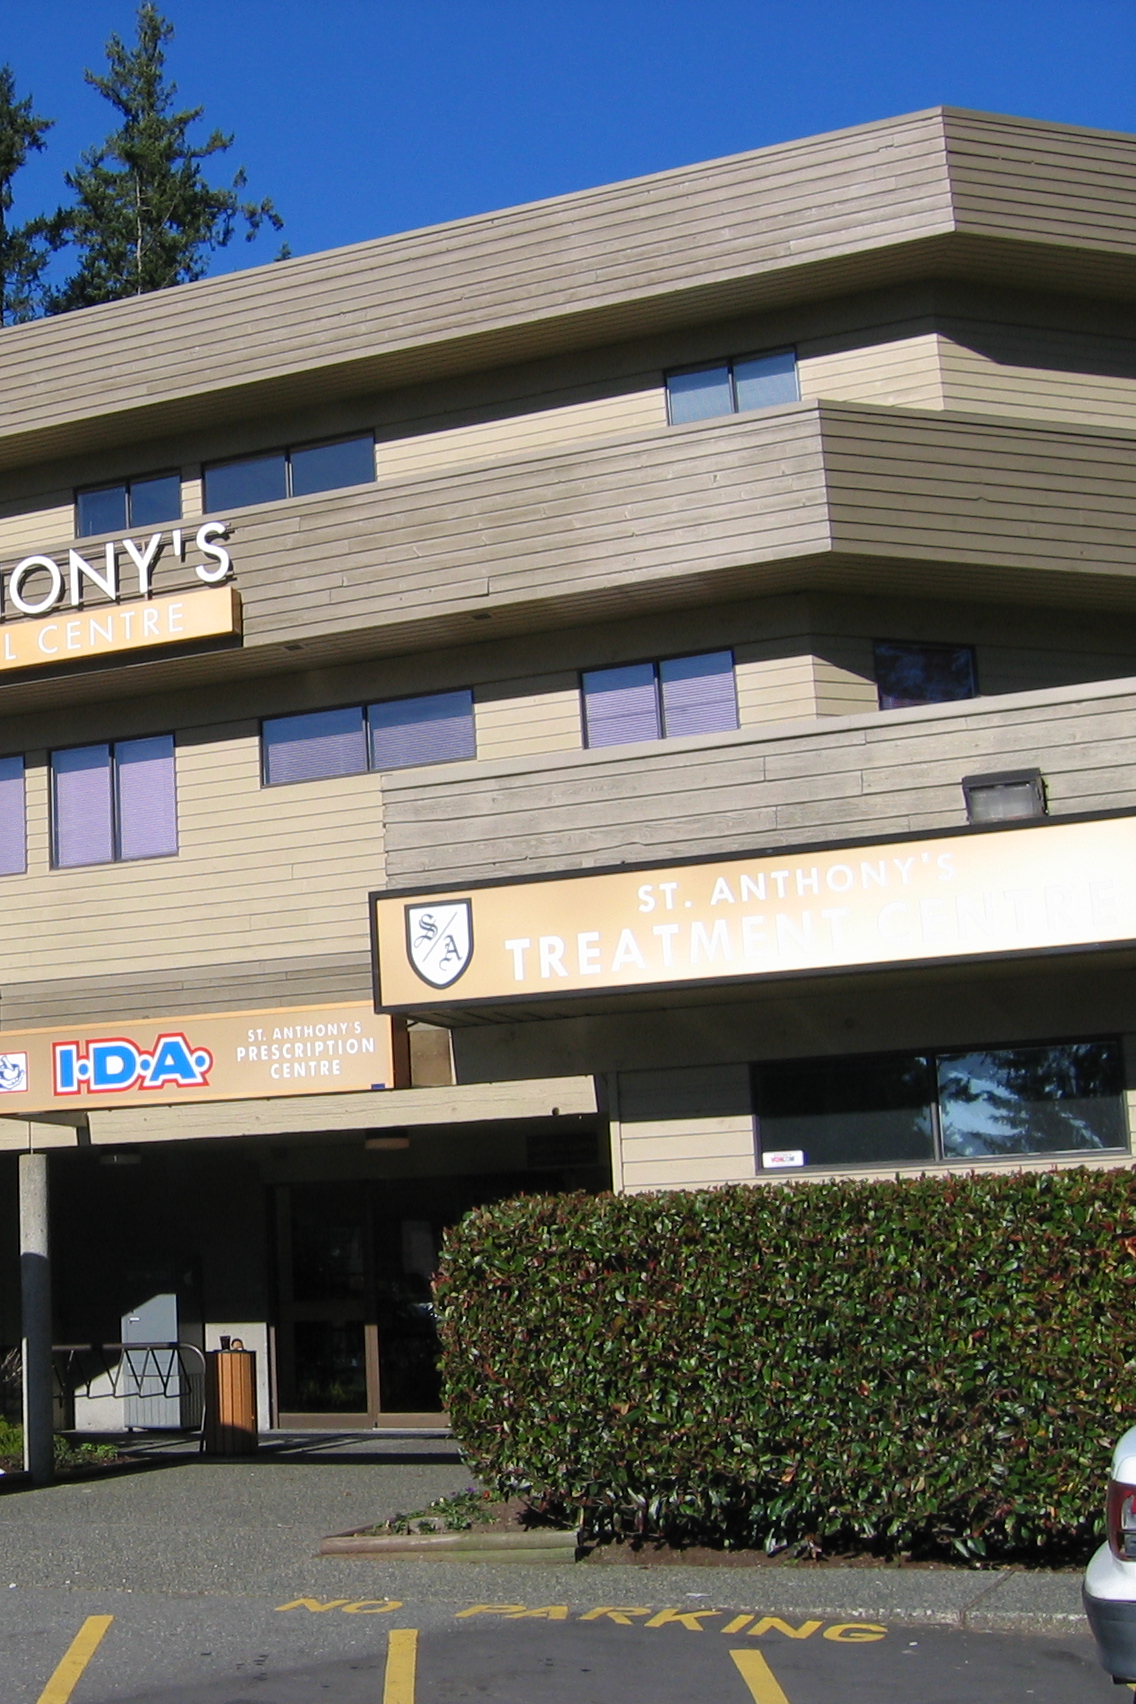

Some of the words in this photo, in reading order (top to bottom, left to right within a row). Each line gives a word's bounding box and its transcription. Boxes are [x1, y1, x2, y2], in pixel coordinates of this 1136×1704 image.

[37, 602, 186, 654] CENTRE
[637, 882, 693, 914] ST.
[709, 852, 958, 905] ANTHONY'S
[504, 907, 849, 982] TREATMENT
[877, 880, 1120, 946] CENTRE
[236, 1037, 375, 1062] PRESCRIPTION
[247, 1028, 267, 1043] ST.
[272, 1021, 362, 1040] ANTHONY'S
[270, 1059, 342, 1079] CENTRE
[273, 1598, 403, 1615] NO
[454, 1604, 890, 1644] PARKING
